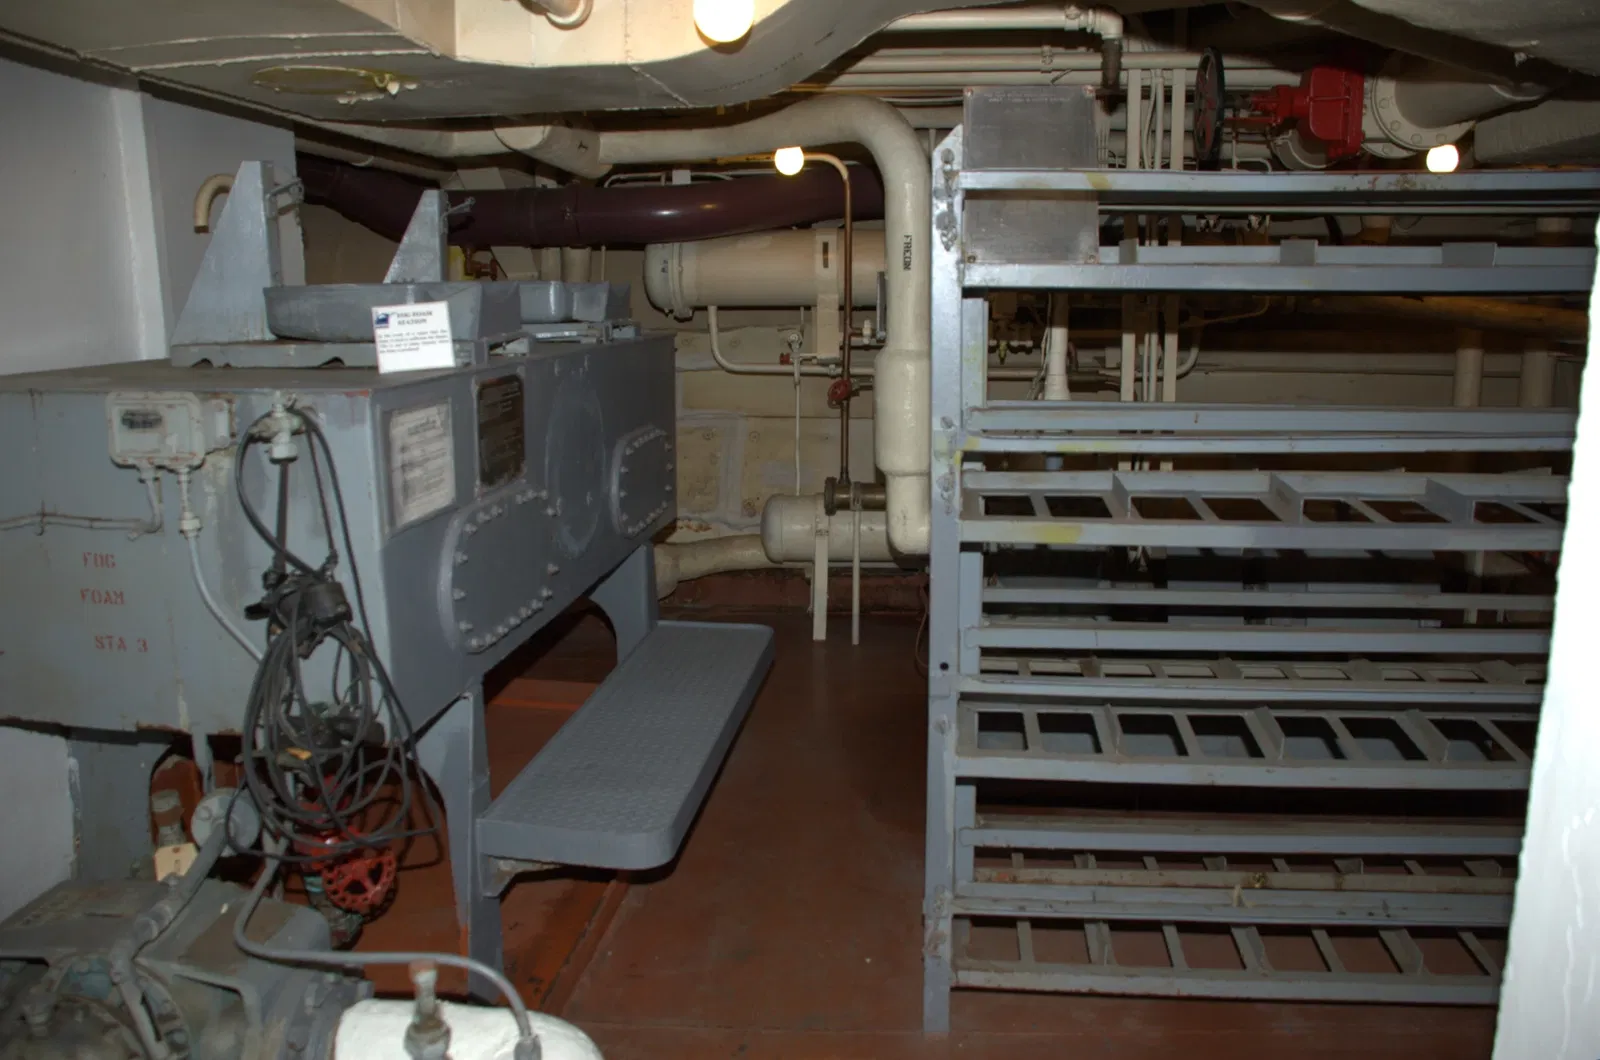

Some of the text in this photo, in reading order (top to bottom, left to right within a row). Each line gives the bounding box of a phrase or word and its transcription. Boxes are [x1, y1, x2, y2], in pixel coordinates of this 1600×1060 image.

[903, 234, 913, 270] FREON
[82, 552, 116, 568] FOG
[80, 588, 125, 605] FOAM
[95, 635, 149, 652] STA 3
